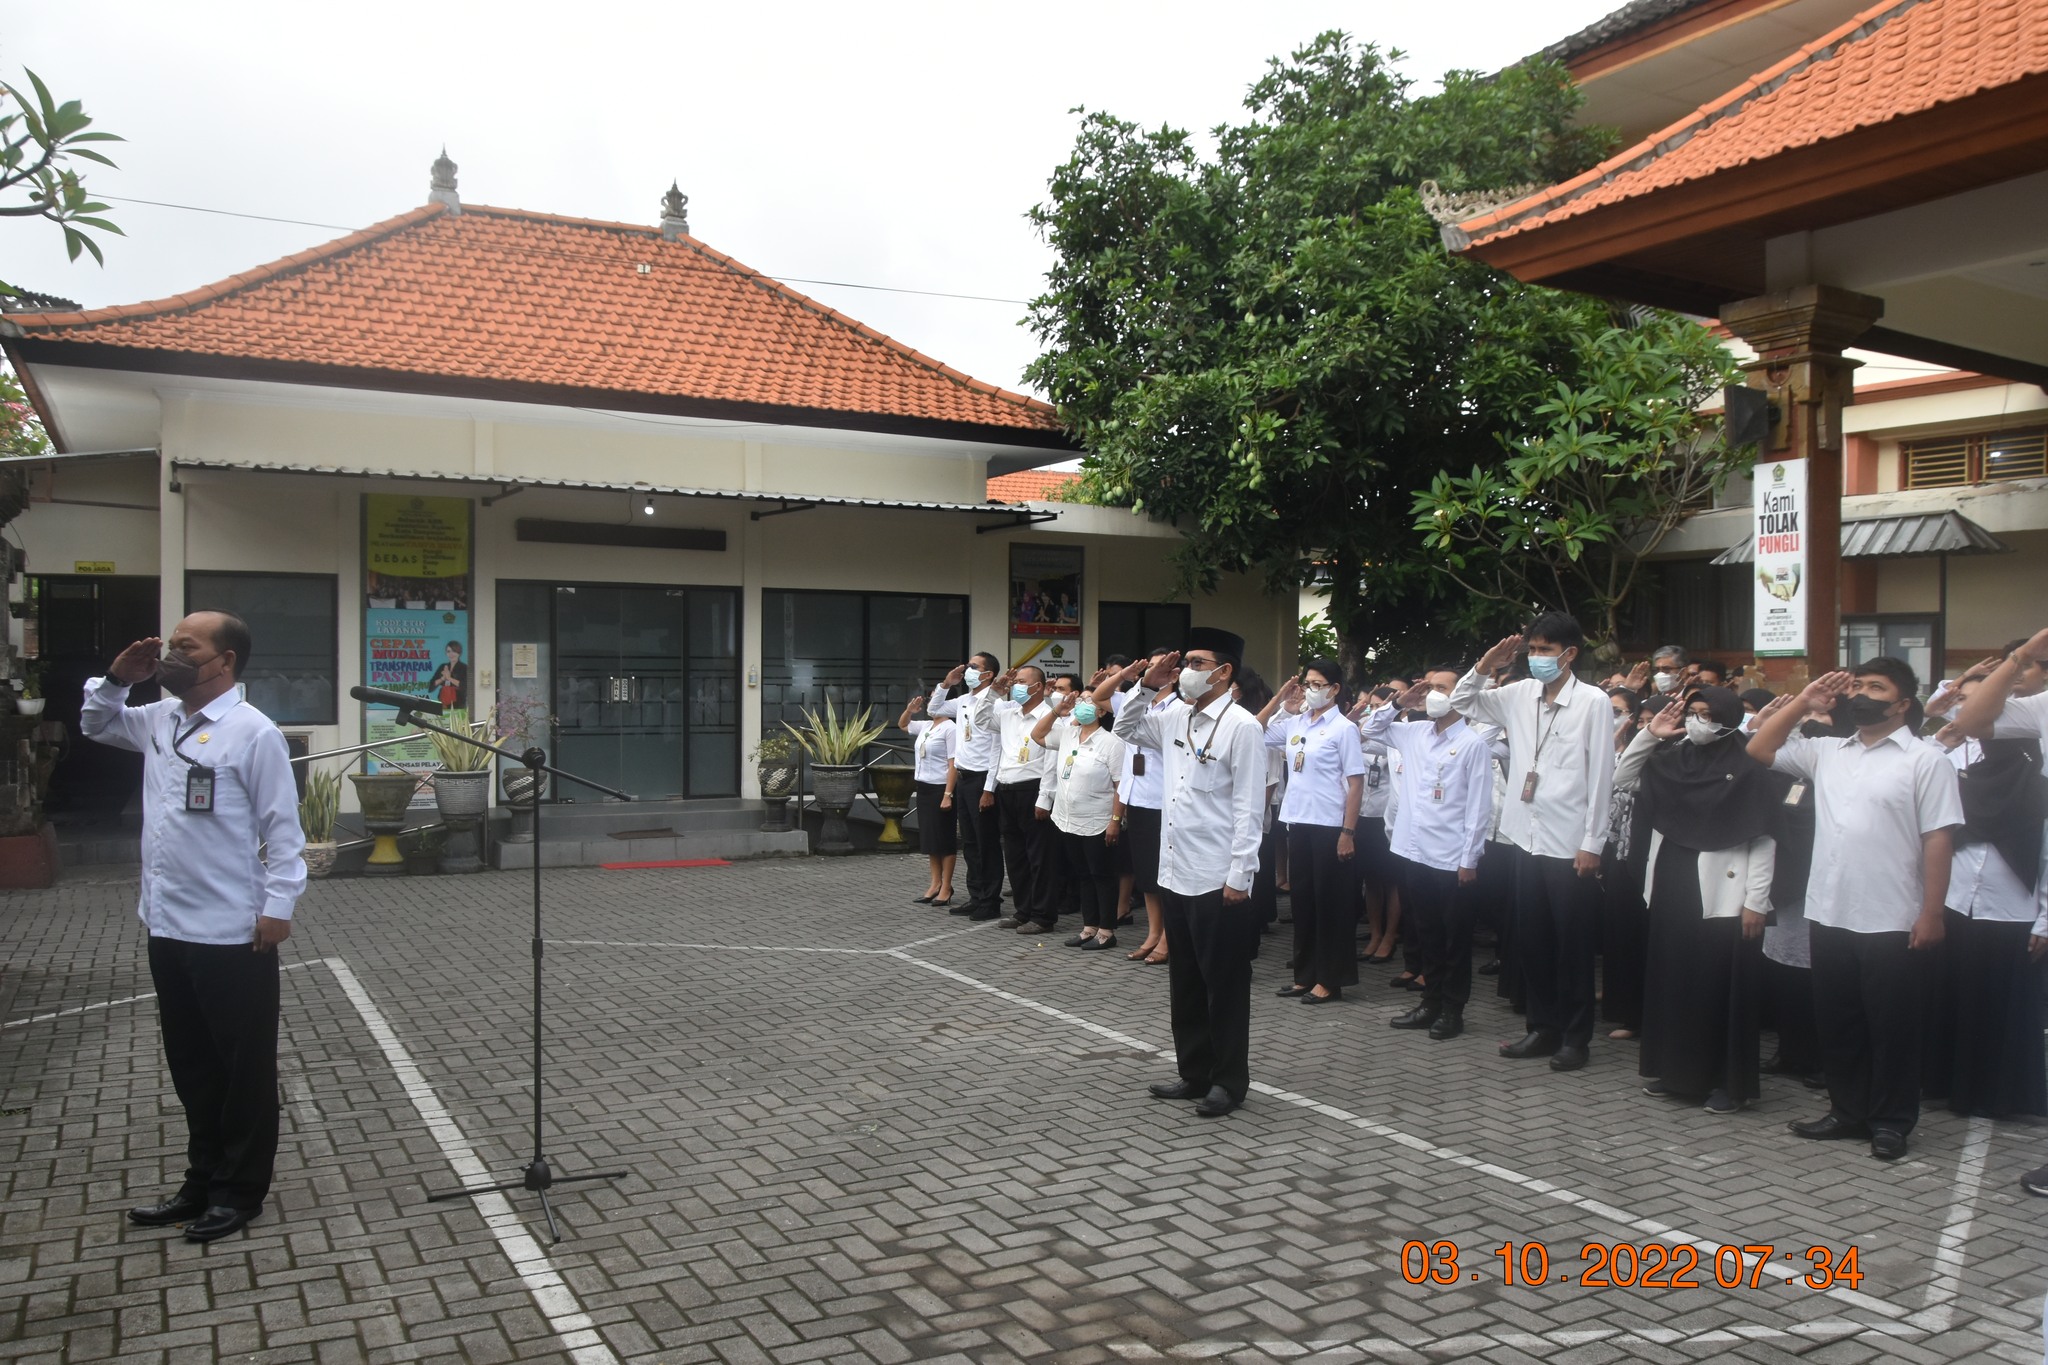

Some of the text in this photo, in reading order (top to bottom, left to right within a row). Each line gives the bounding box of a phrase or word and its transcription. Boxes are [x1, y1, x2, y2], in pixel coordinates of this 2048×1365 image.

[1763, 488, 1795, 514] Kami
[1759, 511, 1799, 535] TOLAK
[1758, 533, 1800, 555] PUNGLI
[370, 639, 426, 649] CEPAT
[372, 649, 431, 660] MUDAH
[369, 660, 433, 672] TRANSPARAN
[372, 671, 418, 683] PASTI
